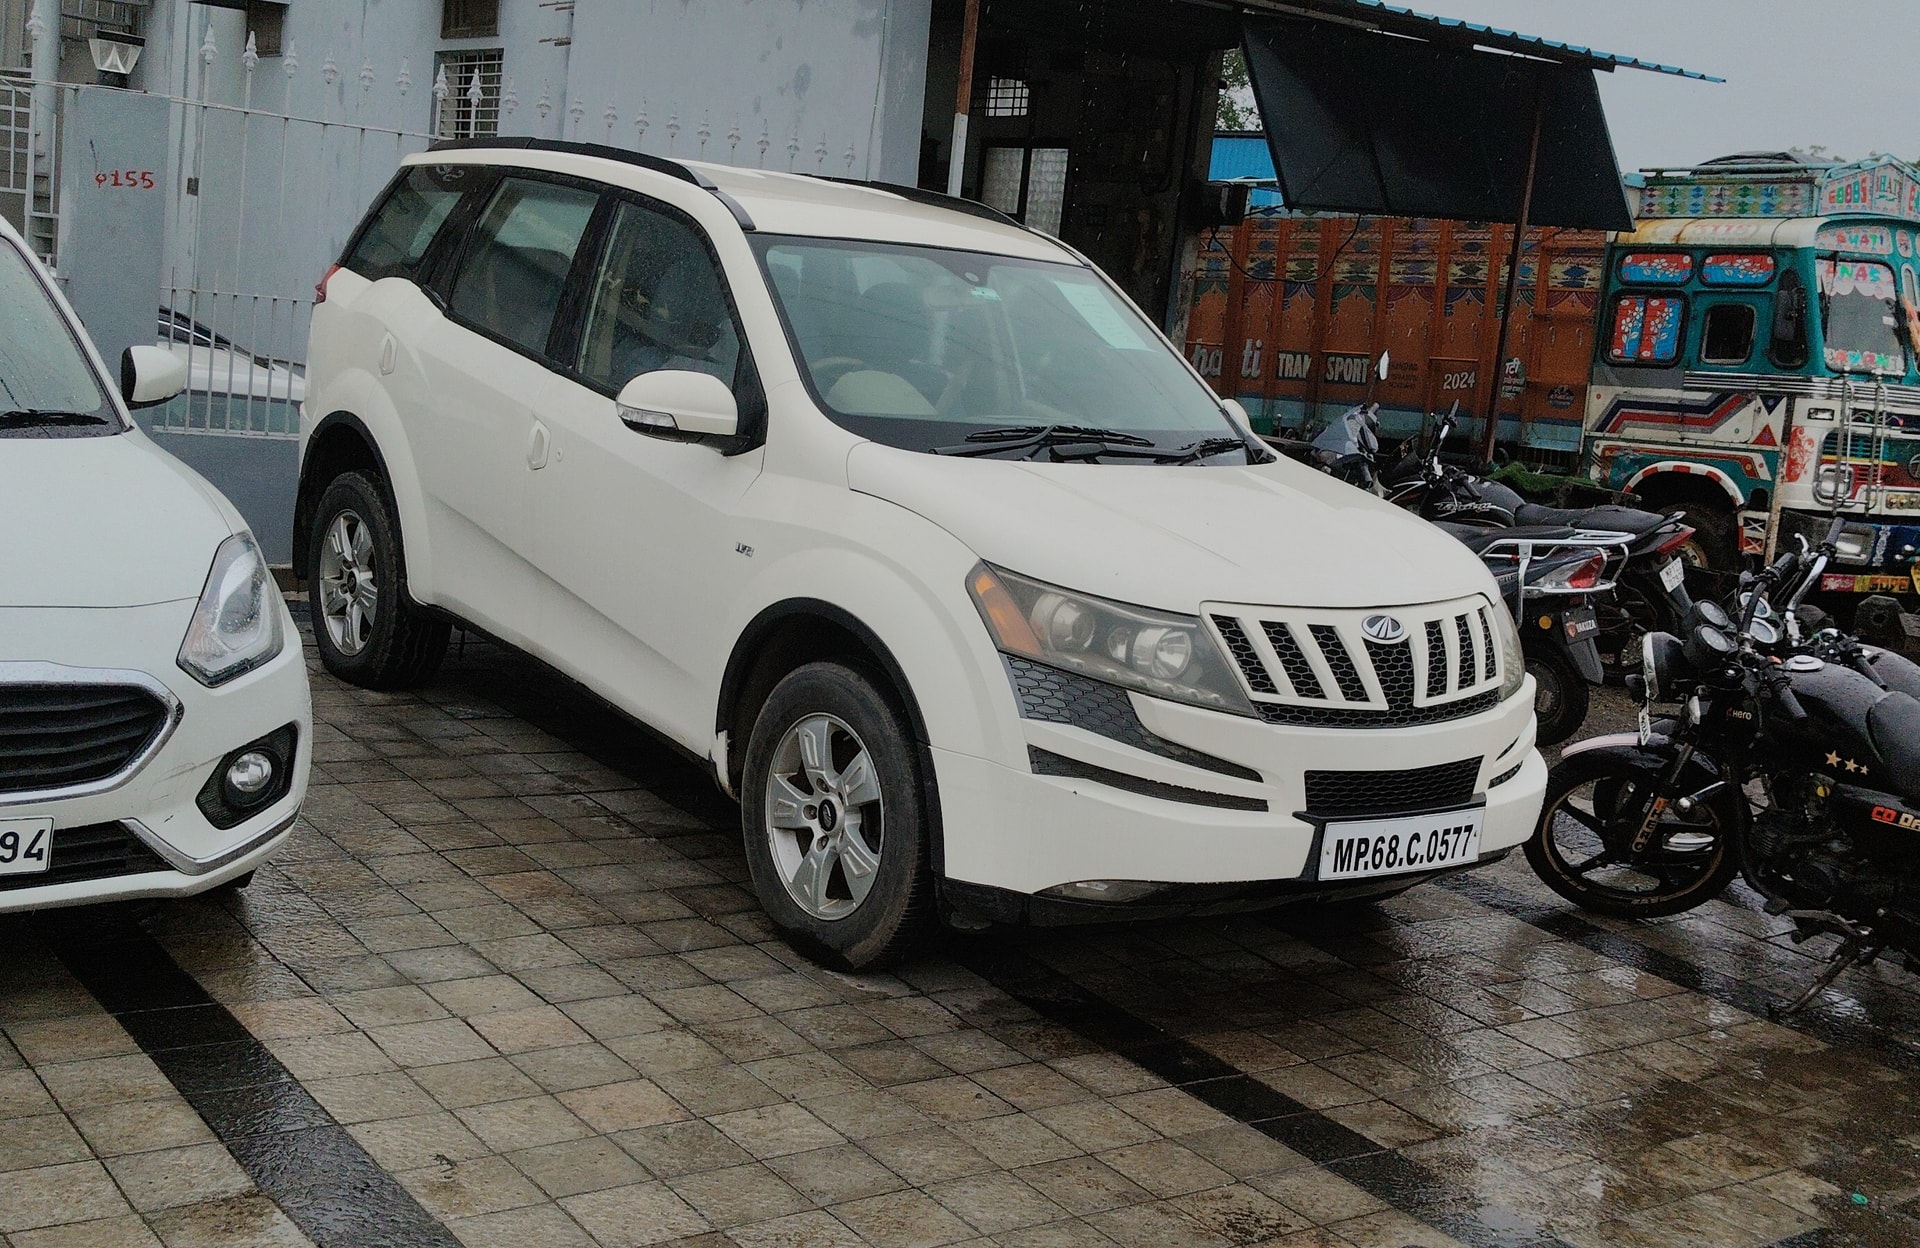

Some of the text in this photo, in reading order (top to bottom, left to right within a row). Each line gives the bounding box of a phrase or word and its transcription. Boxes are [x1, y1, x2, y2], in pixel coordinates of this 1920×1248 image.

[1241, 338, 1263, 378] ti
[1325, 356, 1370, 383] SPORT
[1442, 371, 1476, 390] 2024
[1871, 806, 1897, 822] CD
[0, 829, 46, 863] 94
[1333, 824, 1474, 873] MP.68.C.0577
